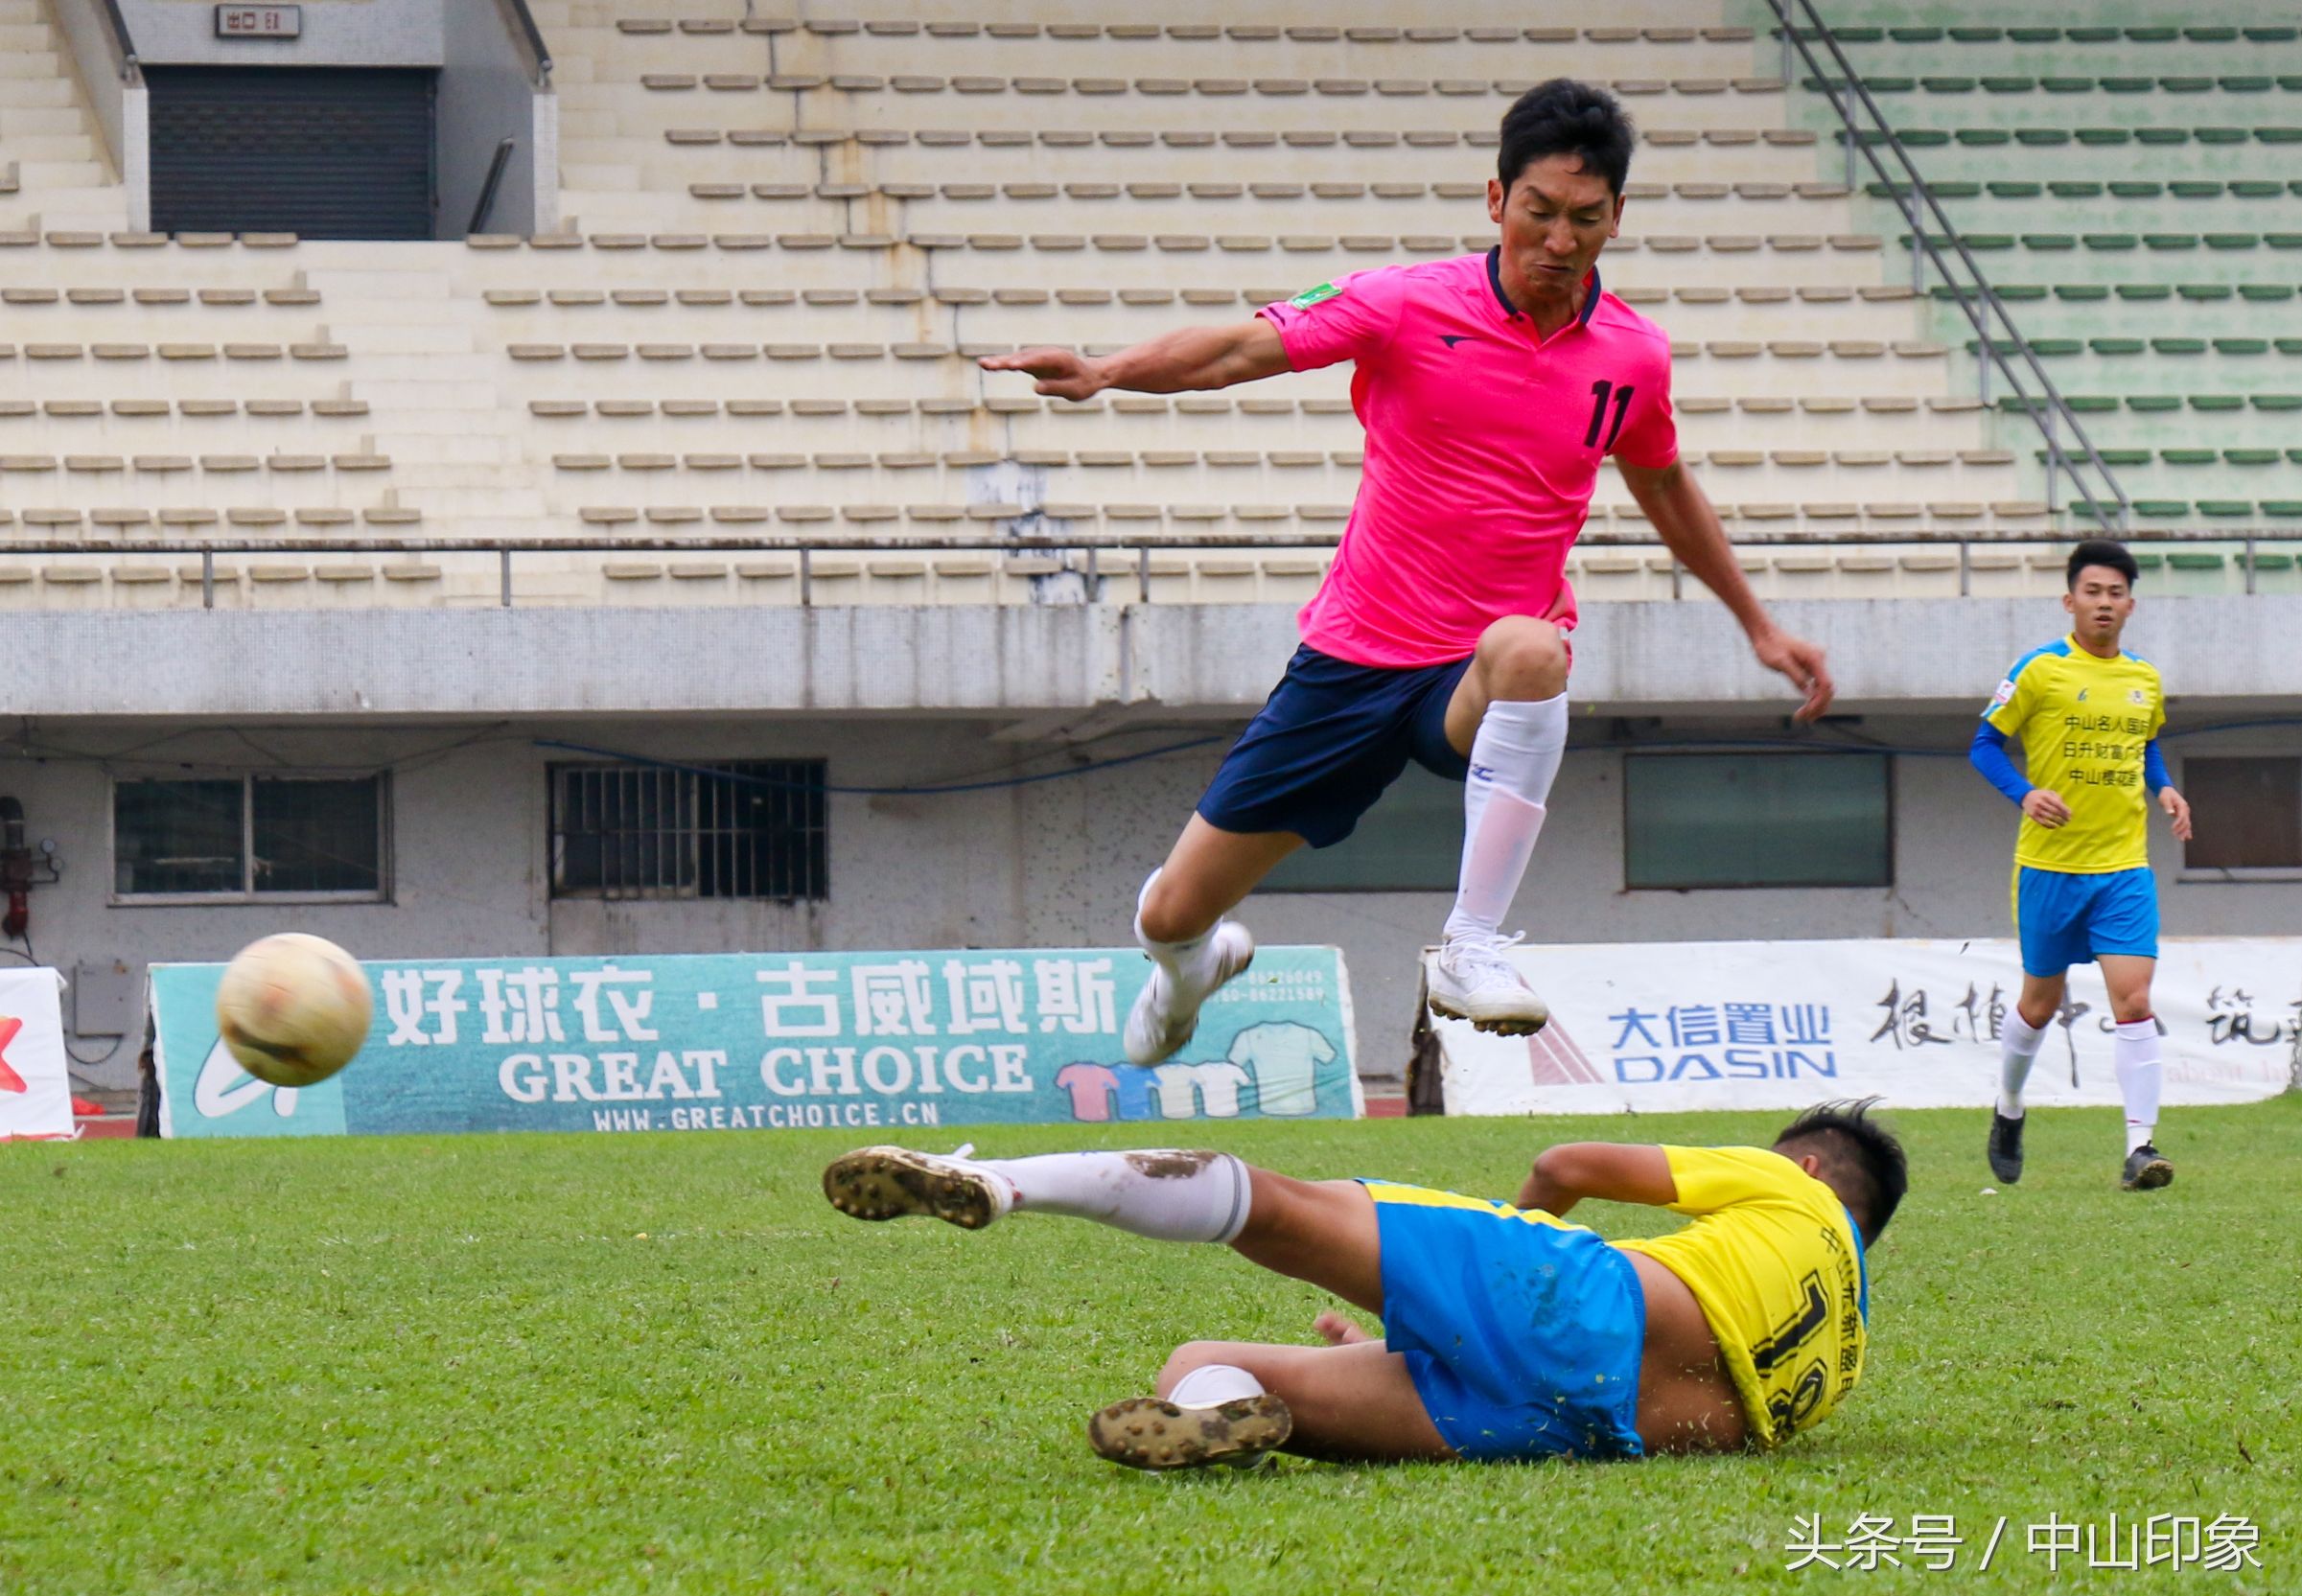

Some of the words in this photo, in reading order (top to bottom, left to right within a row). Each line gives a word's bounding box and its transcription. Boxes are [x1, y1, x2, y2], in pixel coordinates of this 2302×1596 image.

[1584, 379, 1635, 454] 11
[381, 965, 660, 1047] 好球衣
[756, 958, 1117, 1038] 古威域斯
[1608, 1002, 1832, 1050] 大信置业
[498, 1050, 728, 1103] GREAT
[759, 1043, 1035, 1096] CHOICE
[1614, 1048, 1838, 1083] DASIN
[592, 1101, 941, 1132] WWW.GREATCHOICE.CN
